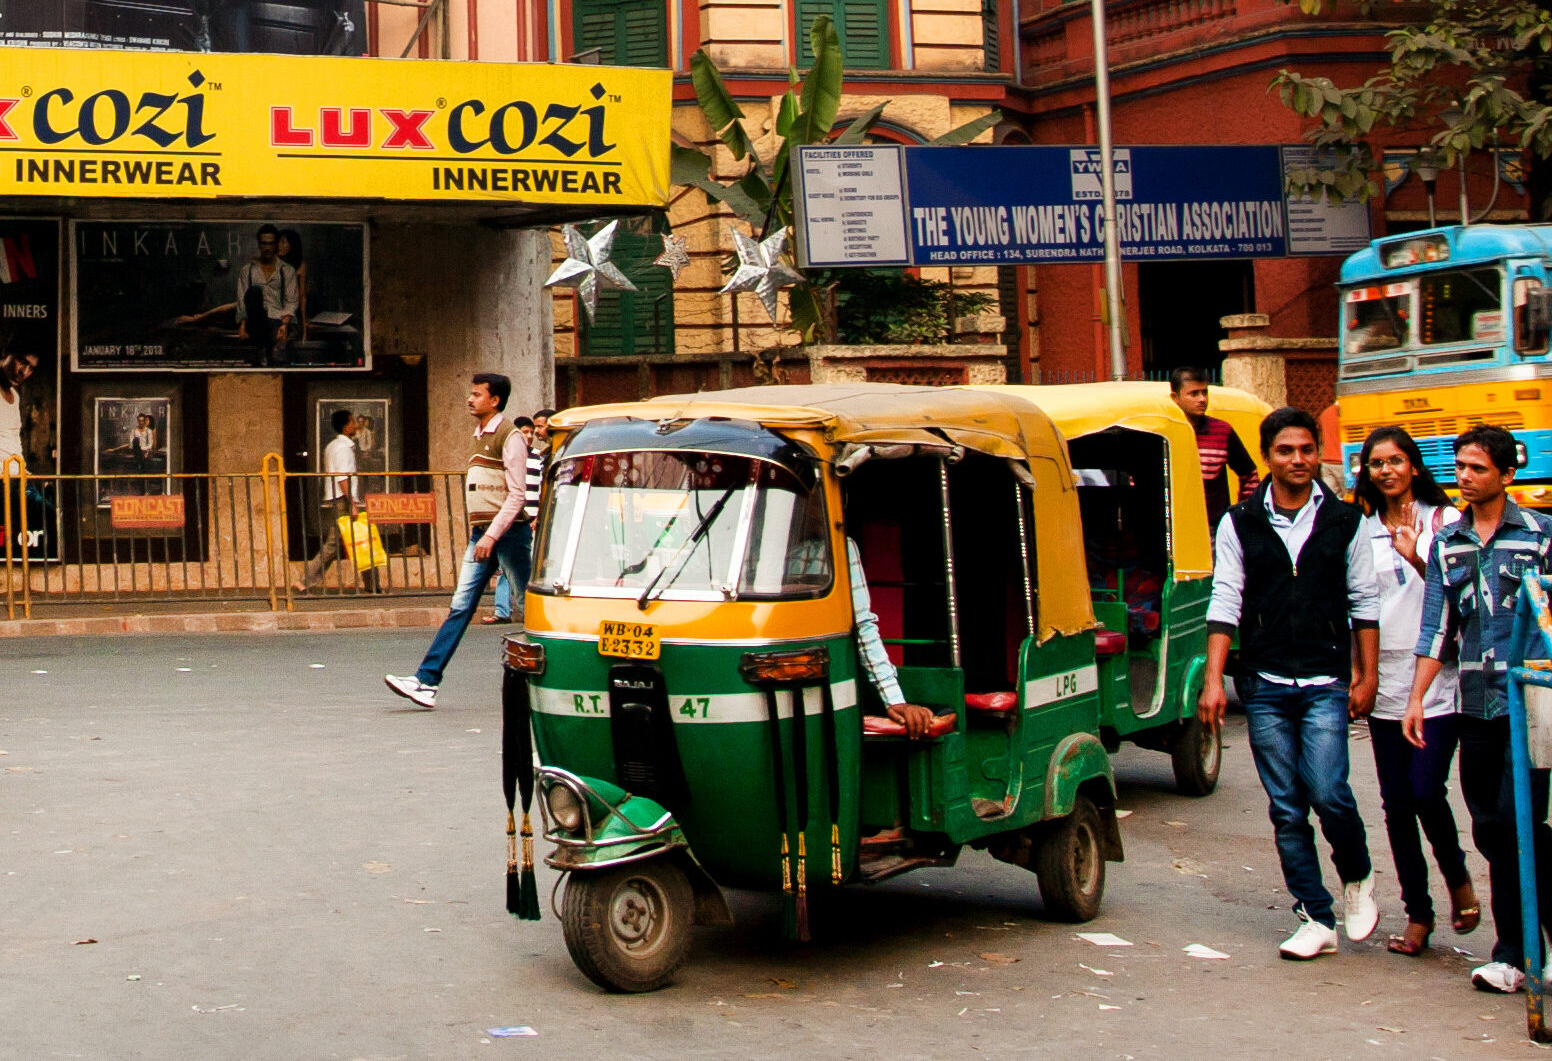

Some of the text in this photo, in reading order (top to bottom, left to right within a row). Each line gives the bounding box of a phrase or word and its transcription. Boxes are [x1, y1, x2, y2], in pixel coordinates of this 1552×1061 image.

[15, 158, 222, 186] INNERWEAR
[1074, 162, 1127, 173] YWA
[432, 167, 623, 195] INNERWEAR
[913, 200, 1284, 246] THE YOUNG WOMEN'S CRISTIAN ASSOCIATION
[80, 229, 242, 258] INKAAR
[929, 251, 957, 261] HEAD
[959, 250, 995, 260] OFFICE
[1025, 248, 1077, 259] SURENDRA
[1079, 248, 1105, 258] NATH
[1157, 245, 1186, 256] ROAD,
[1188, 244, 1230, 254] KOLKATA
[3, 304, 48, 319] INNERS
[113, 498, 183, 515] CONCAST
[369, 498, 434, 514] CONCAST
[1055, 673, 1078, 699] LPG
[679, 697, 711, 719] 47
